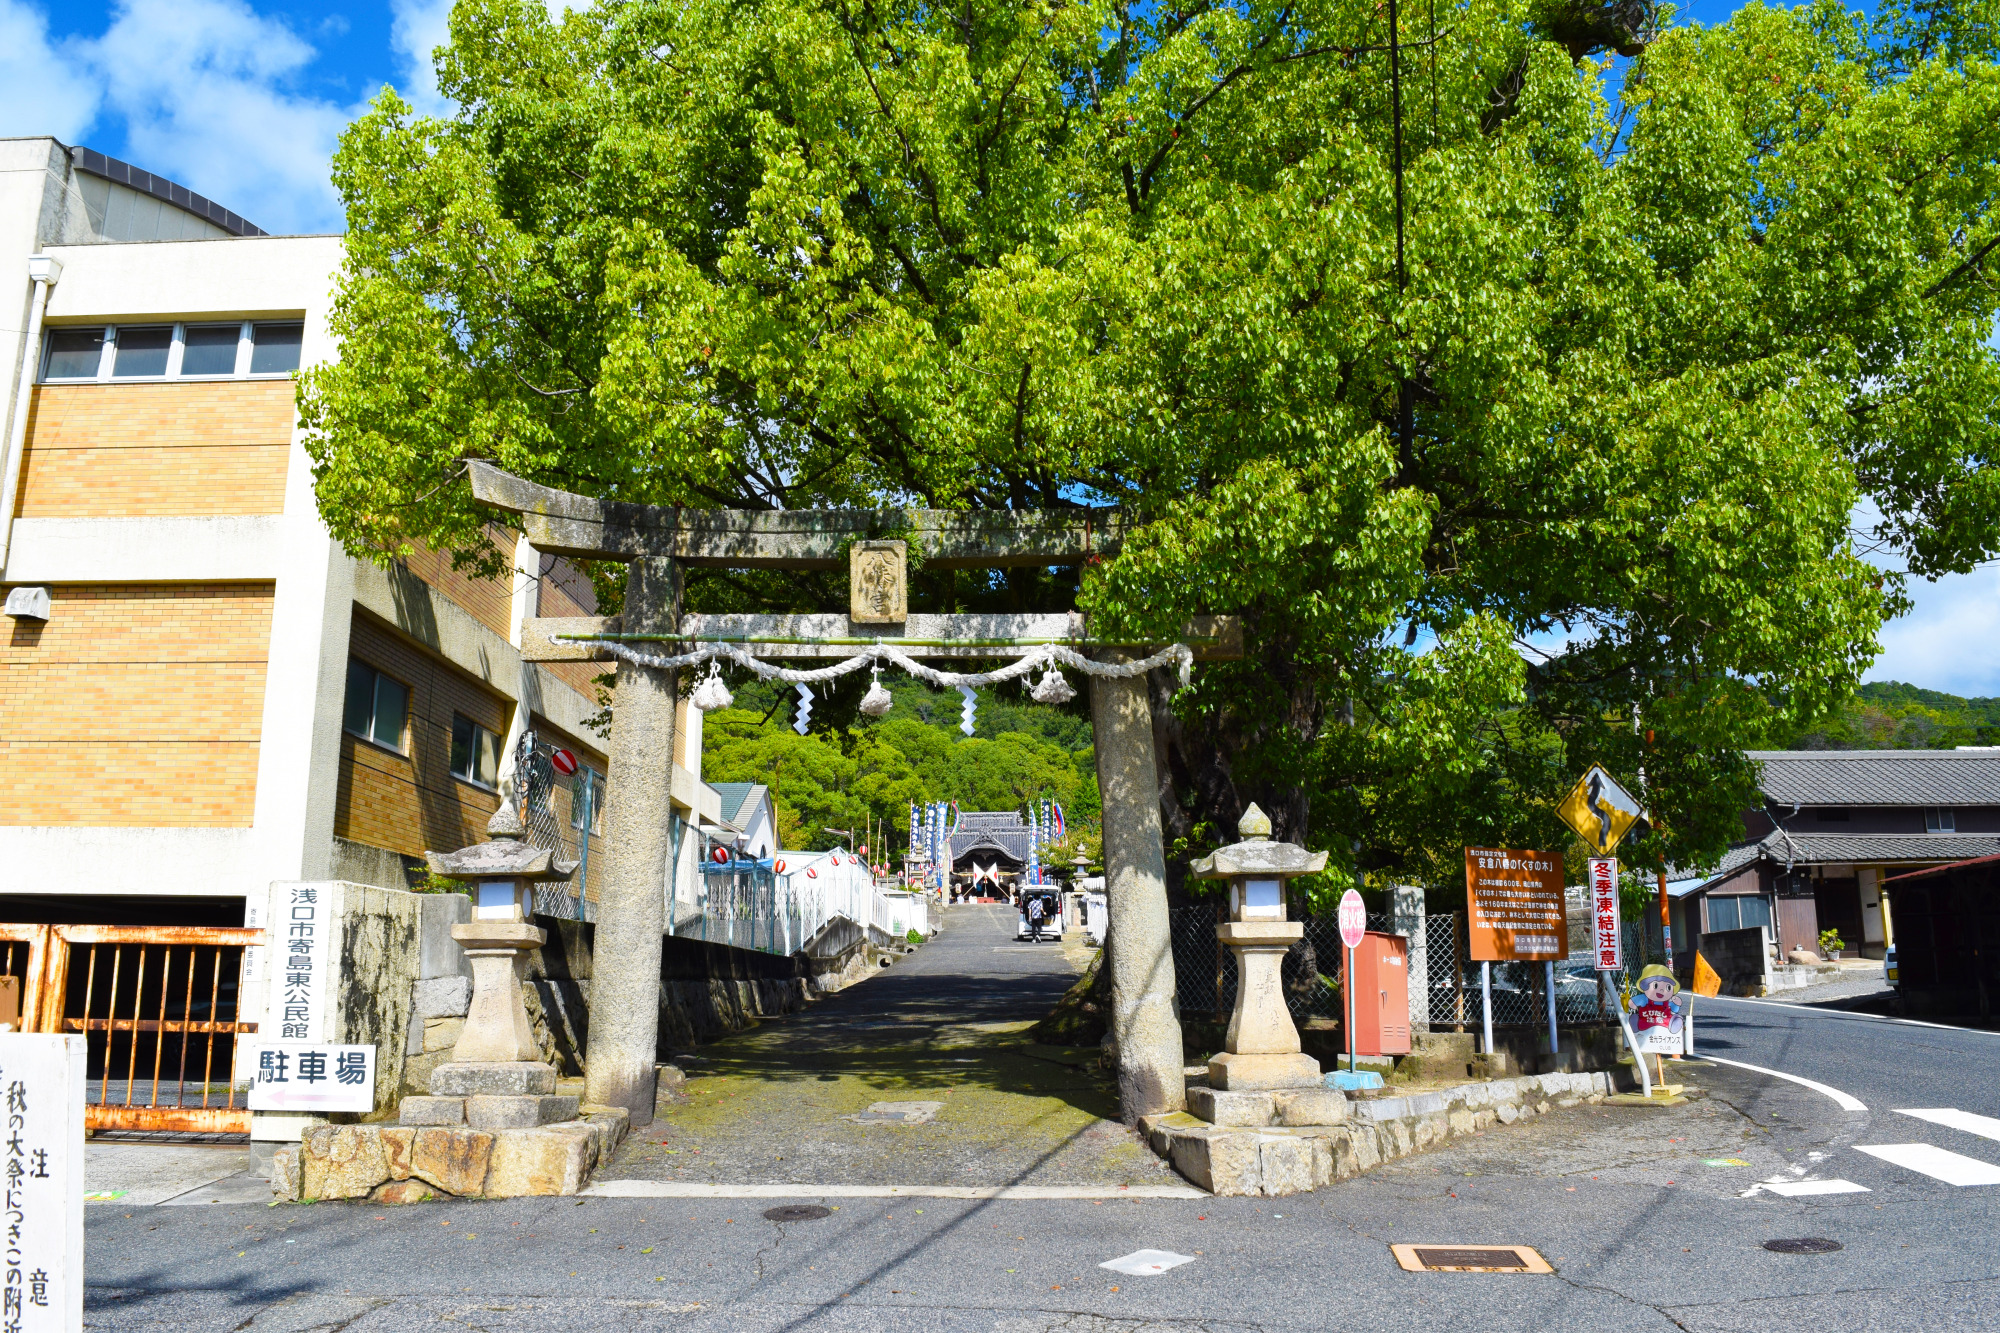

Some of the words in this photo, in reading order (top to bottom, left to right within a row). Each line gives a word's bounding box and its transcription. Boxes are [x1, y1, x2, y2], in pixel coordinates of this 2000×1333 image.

[1478, 857, 1553, 872] 安倉八幡の「くすの木」
[1341, 908, 1365, 929] 消火栓
[1594, 862, 1617, 966] 冬季凍結注意
[281, 888, 318, 1039] 浅口市寄島東公民館
[1642, 1009, 1667, 1019] とびだし
[1646, 1016, 1665, 1024] 注意
[257, 1050, 367, 1085] 駐車場
